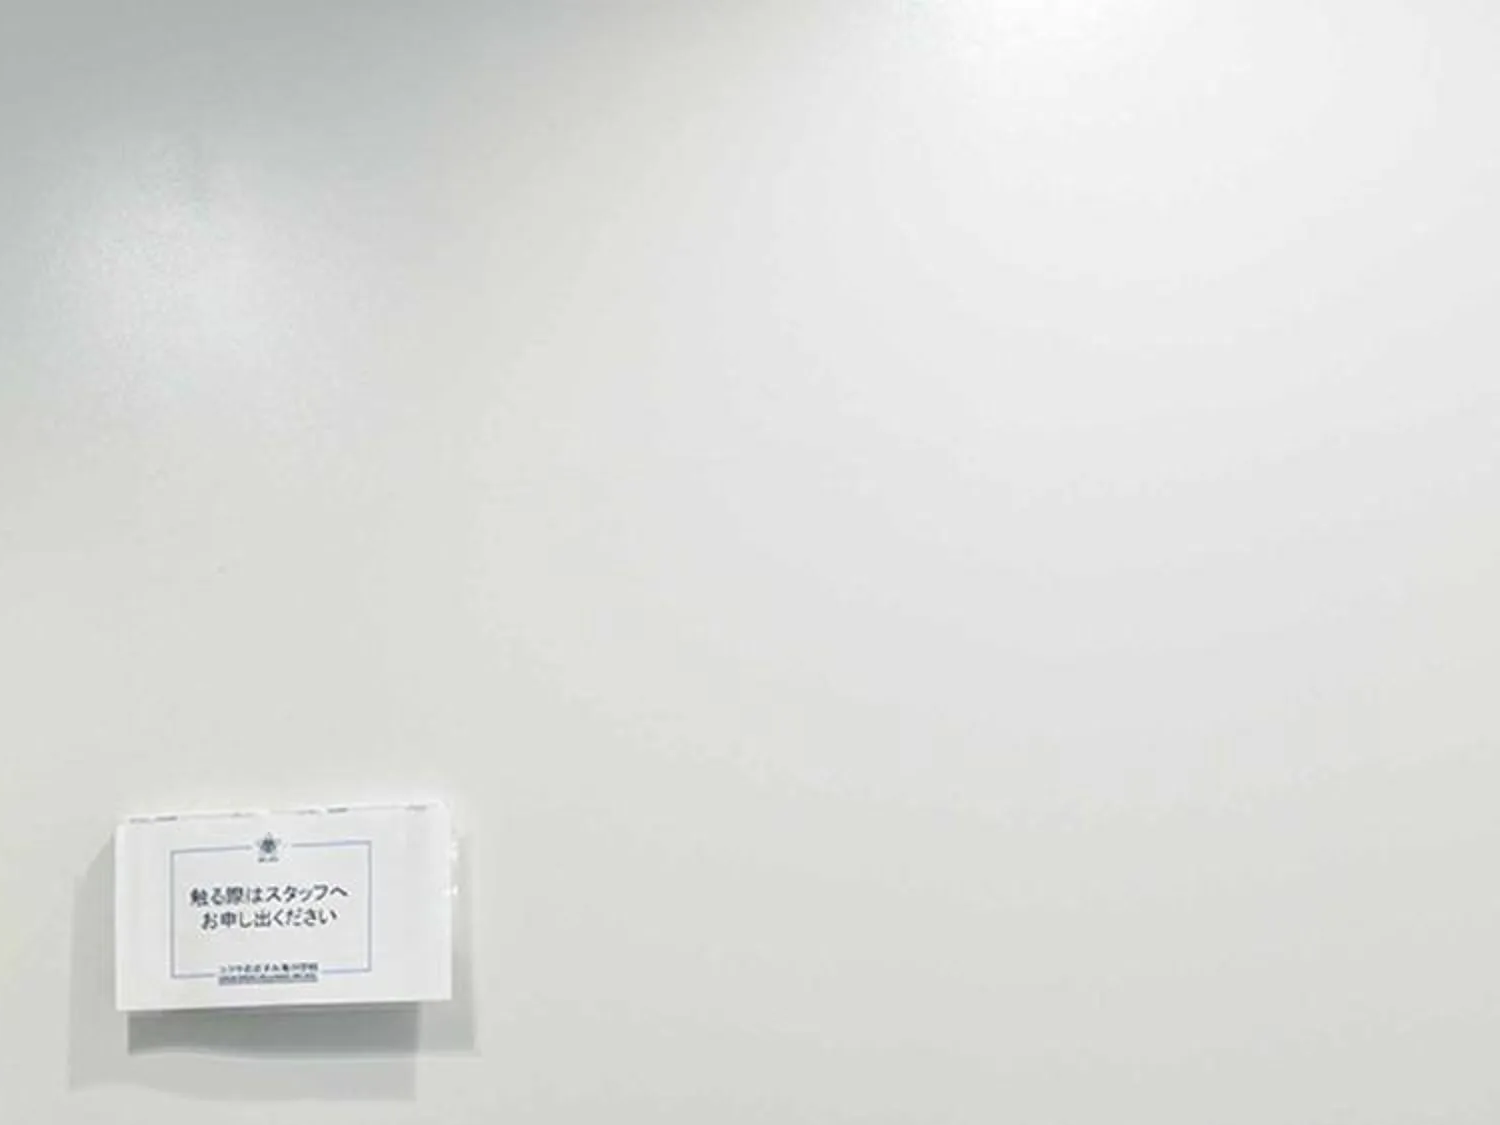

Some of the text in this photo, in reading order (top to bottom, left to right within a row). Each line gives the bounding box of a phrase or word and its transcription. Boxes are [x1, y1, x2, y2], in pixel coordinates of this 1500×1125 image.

[190, 884, 349, 907] 触る際はスタッフへ
[201, 908, 338, 930] お申し出ください
